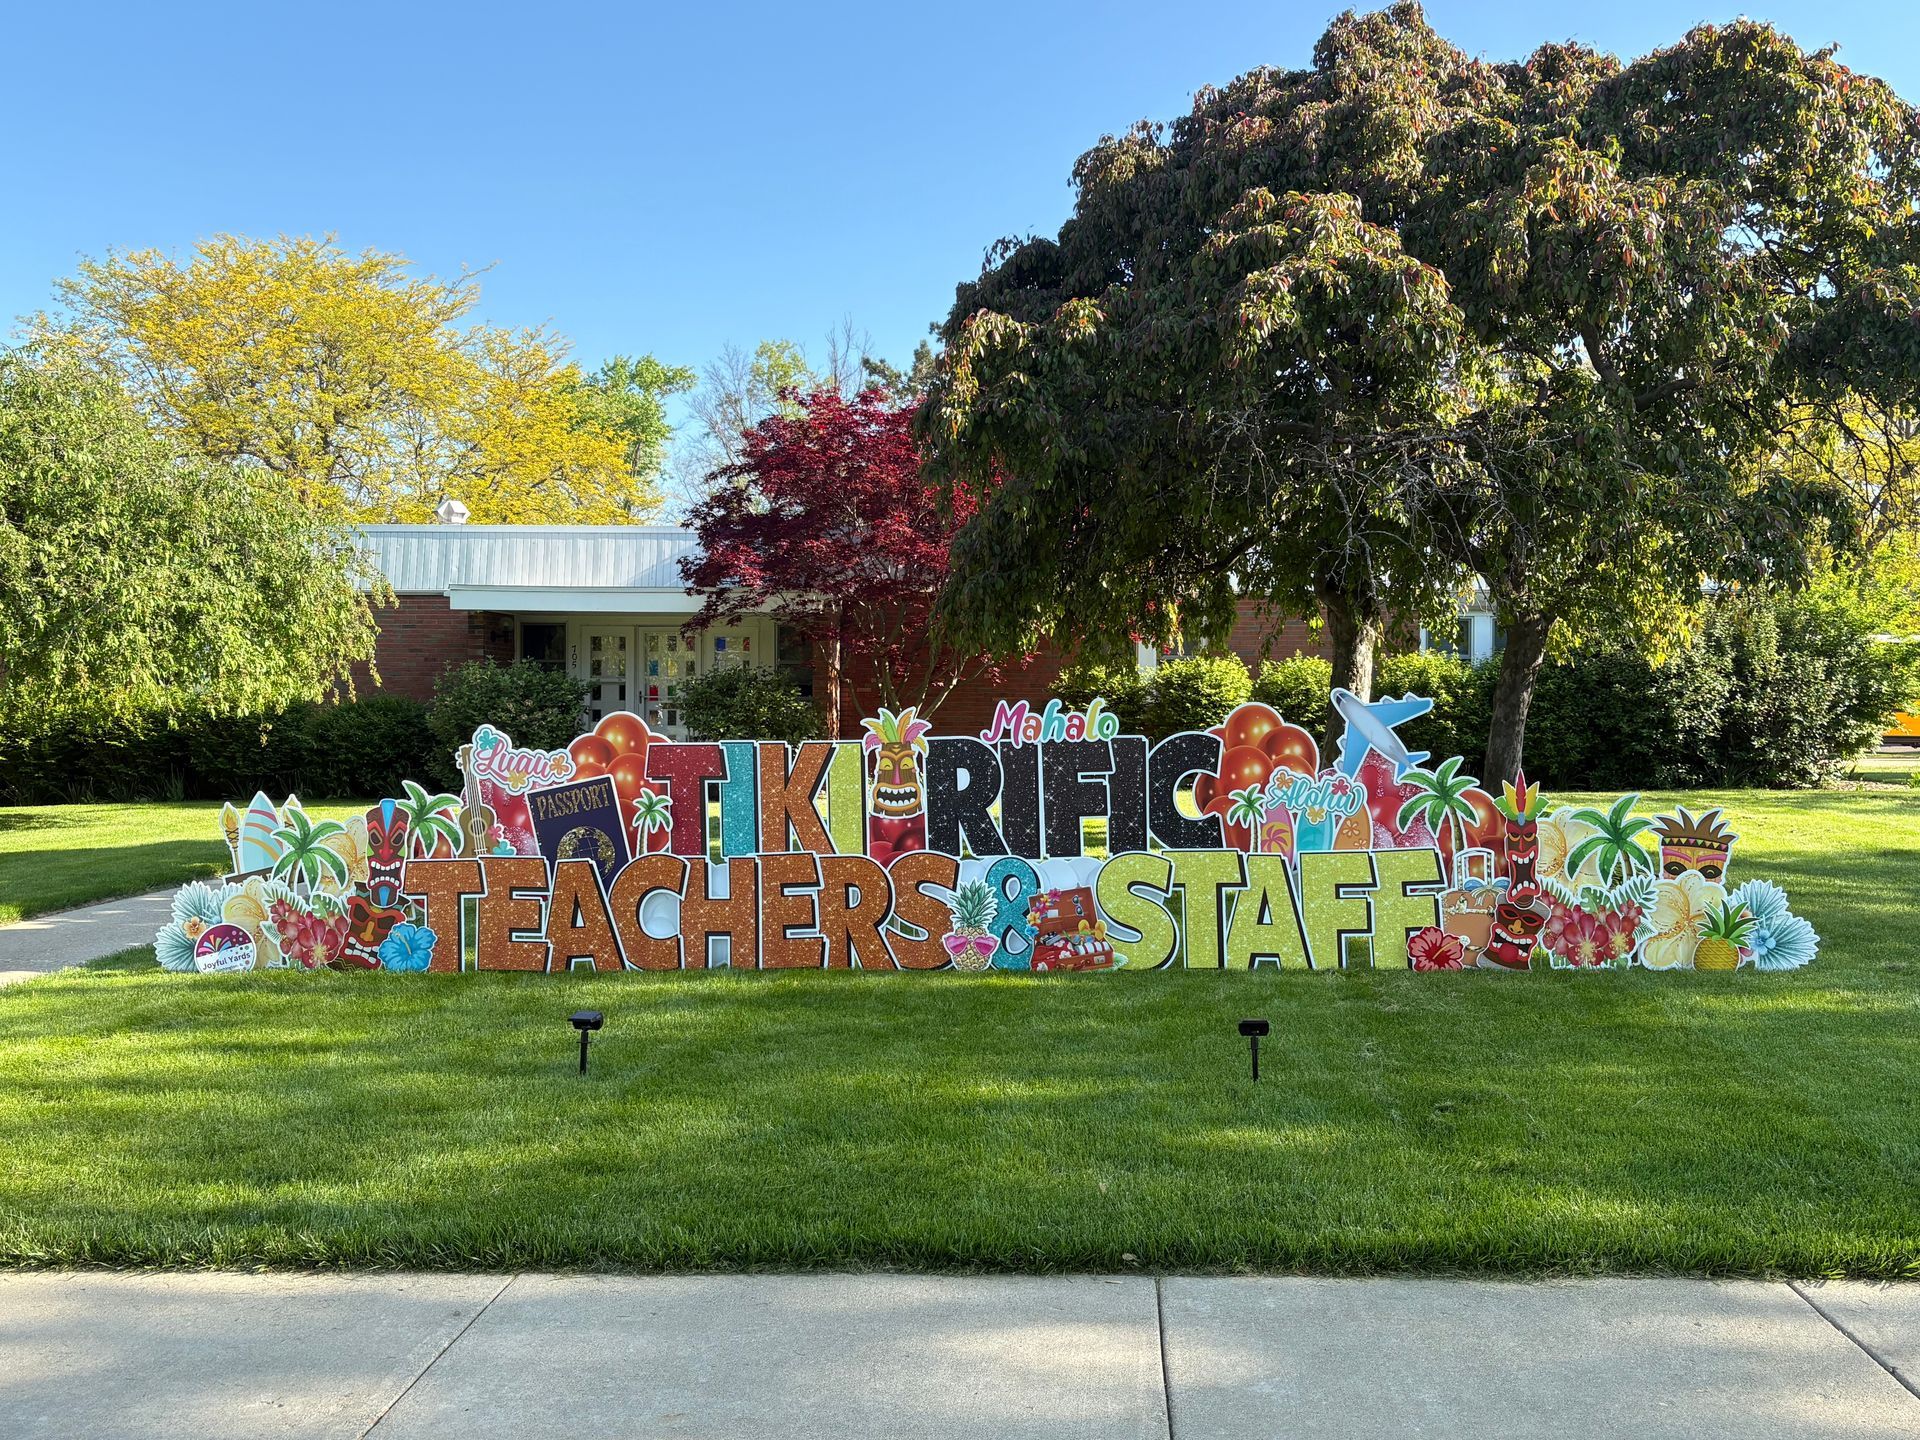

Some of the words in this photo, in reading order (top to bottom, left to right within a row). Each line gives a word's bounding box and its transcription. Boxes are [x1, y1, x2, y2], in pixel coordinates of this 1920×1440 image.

[984, 699, 1117, 747] Mahalo
[476, 738, 551, 782] Luau
[536, 782, 611, 821] PASSPORT
[646, 740, 868, 857] TIKI
[927, 733, 1223, 857] RIFIC
[1267, 776, 1363, 813] Aloha
[404, 853, 959, 972] TEACHERS
[984, 856, 1041, 971] &
[1096, 849, 1446, 970] STAFF
[203, 957, 227, 971] Joyful
[228, 952, 251, 963] Yards
